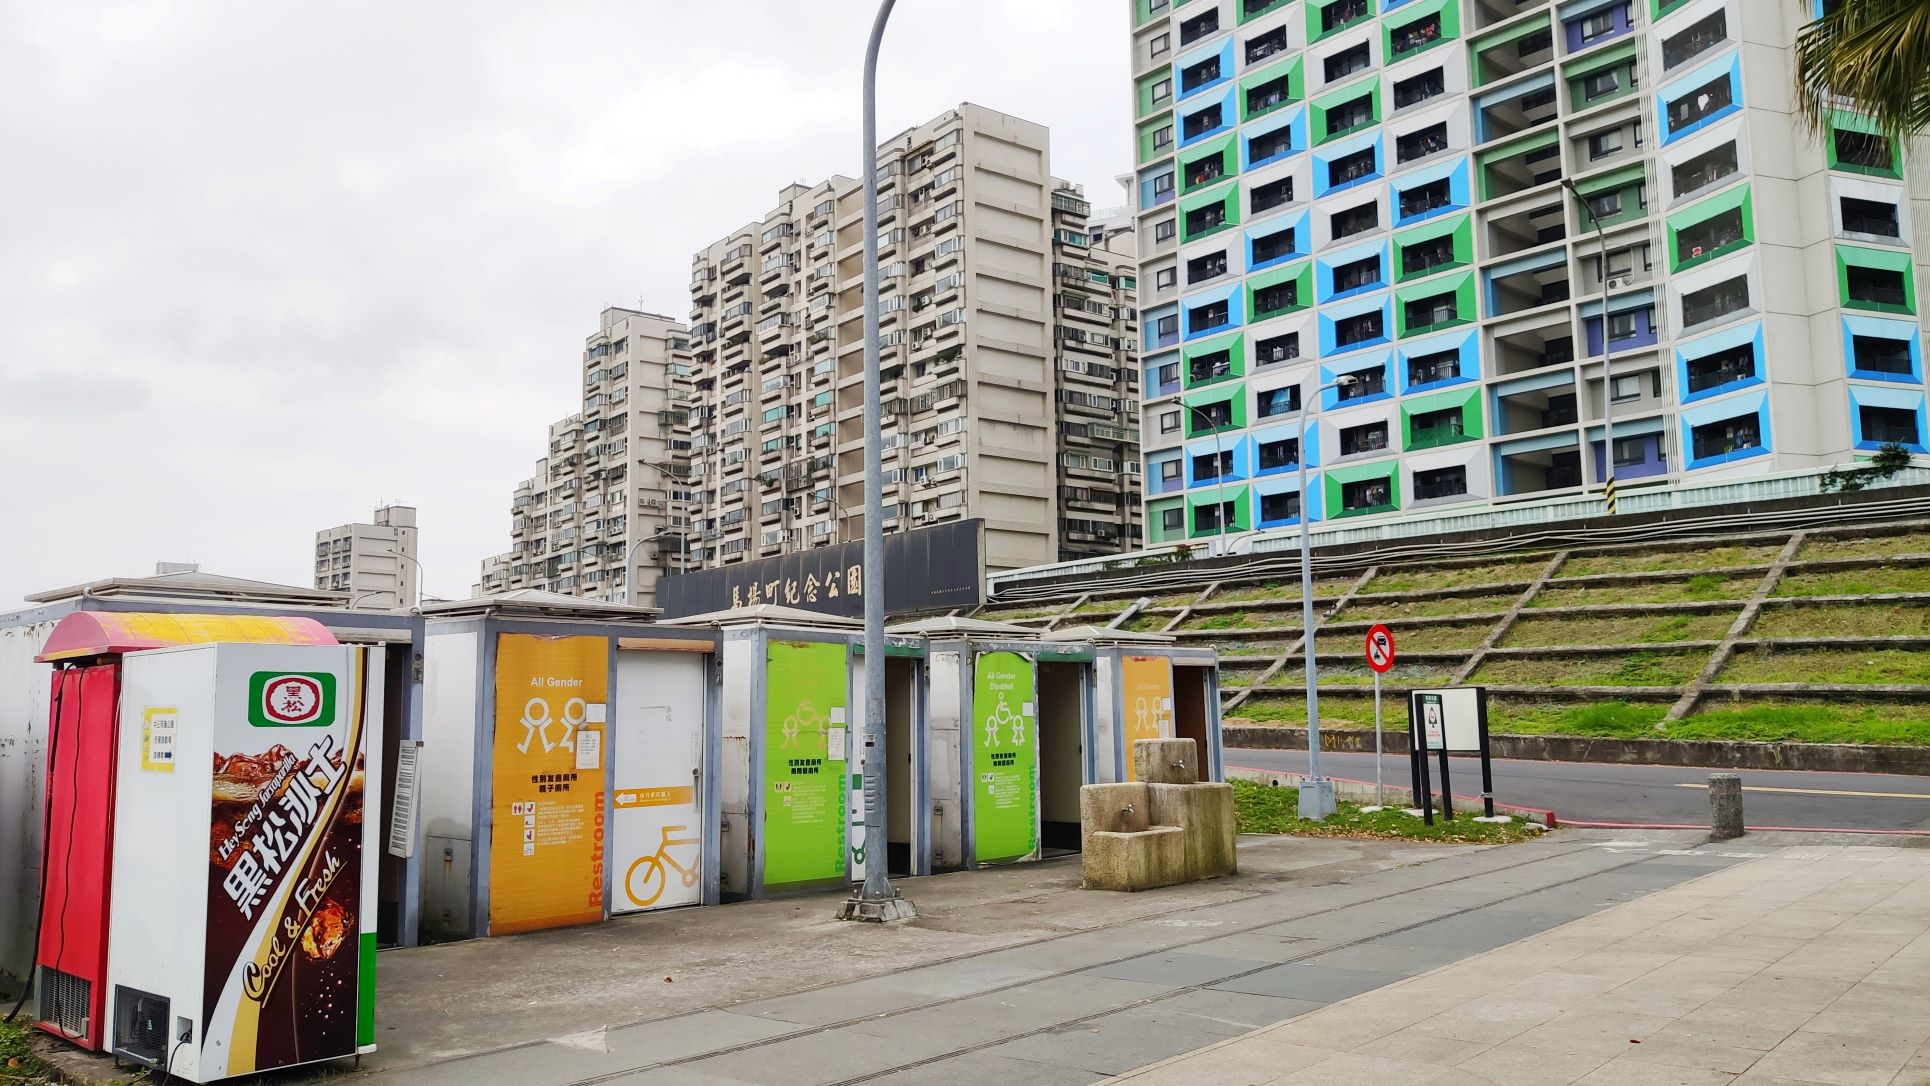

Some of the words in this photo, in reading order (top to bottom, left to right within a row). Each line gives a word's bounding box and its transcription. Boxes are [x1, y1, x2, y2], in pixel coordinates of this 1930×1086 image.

[731, 564, 862, 609] 馬場町紀念公園
[281, 685, 304, 713] 黑松
[530, 676, 544, 687] All
[547, 676, 584, 687] Gender
[589, 791, 605, 907] Restroom
[835, 774, 846, 872] Restroom
[243, 936, 286, 1002] Cool
[284, 916, 300, 938] &
[295, 851, 340, 918] Fresh
